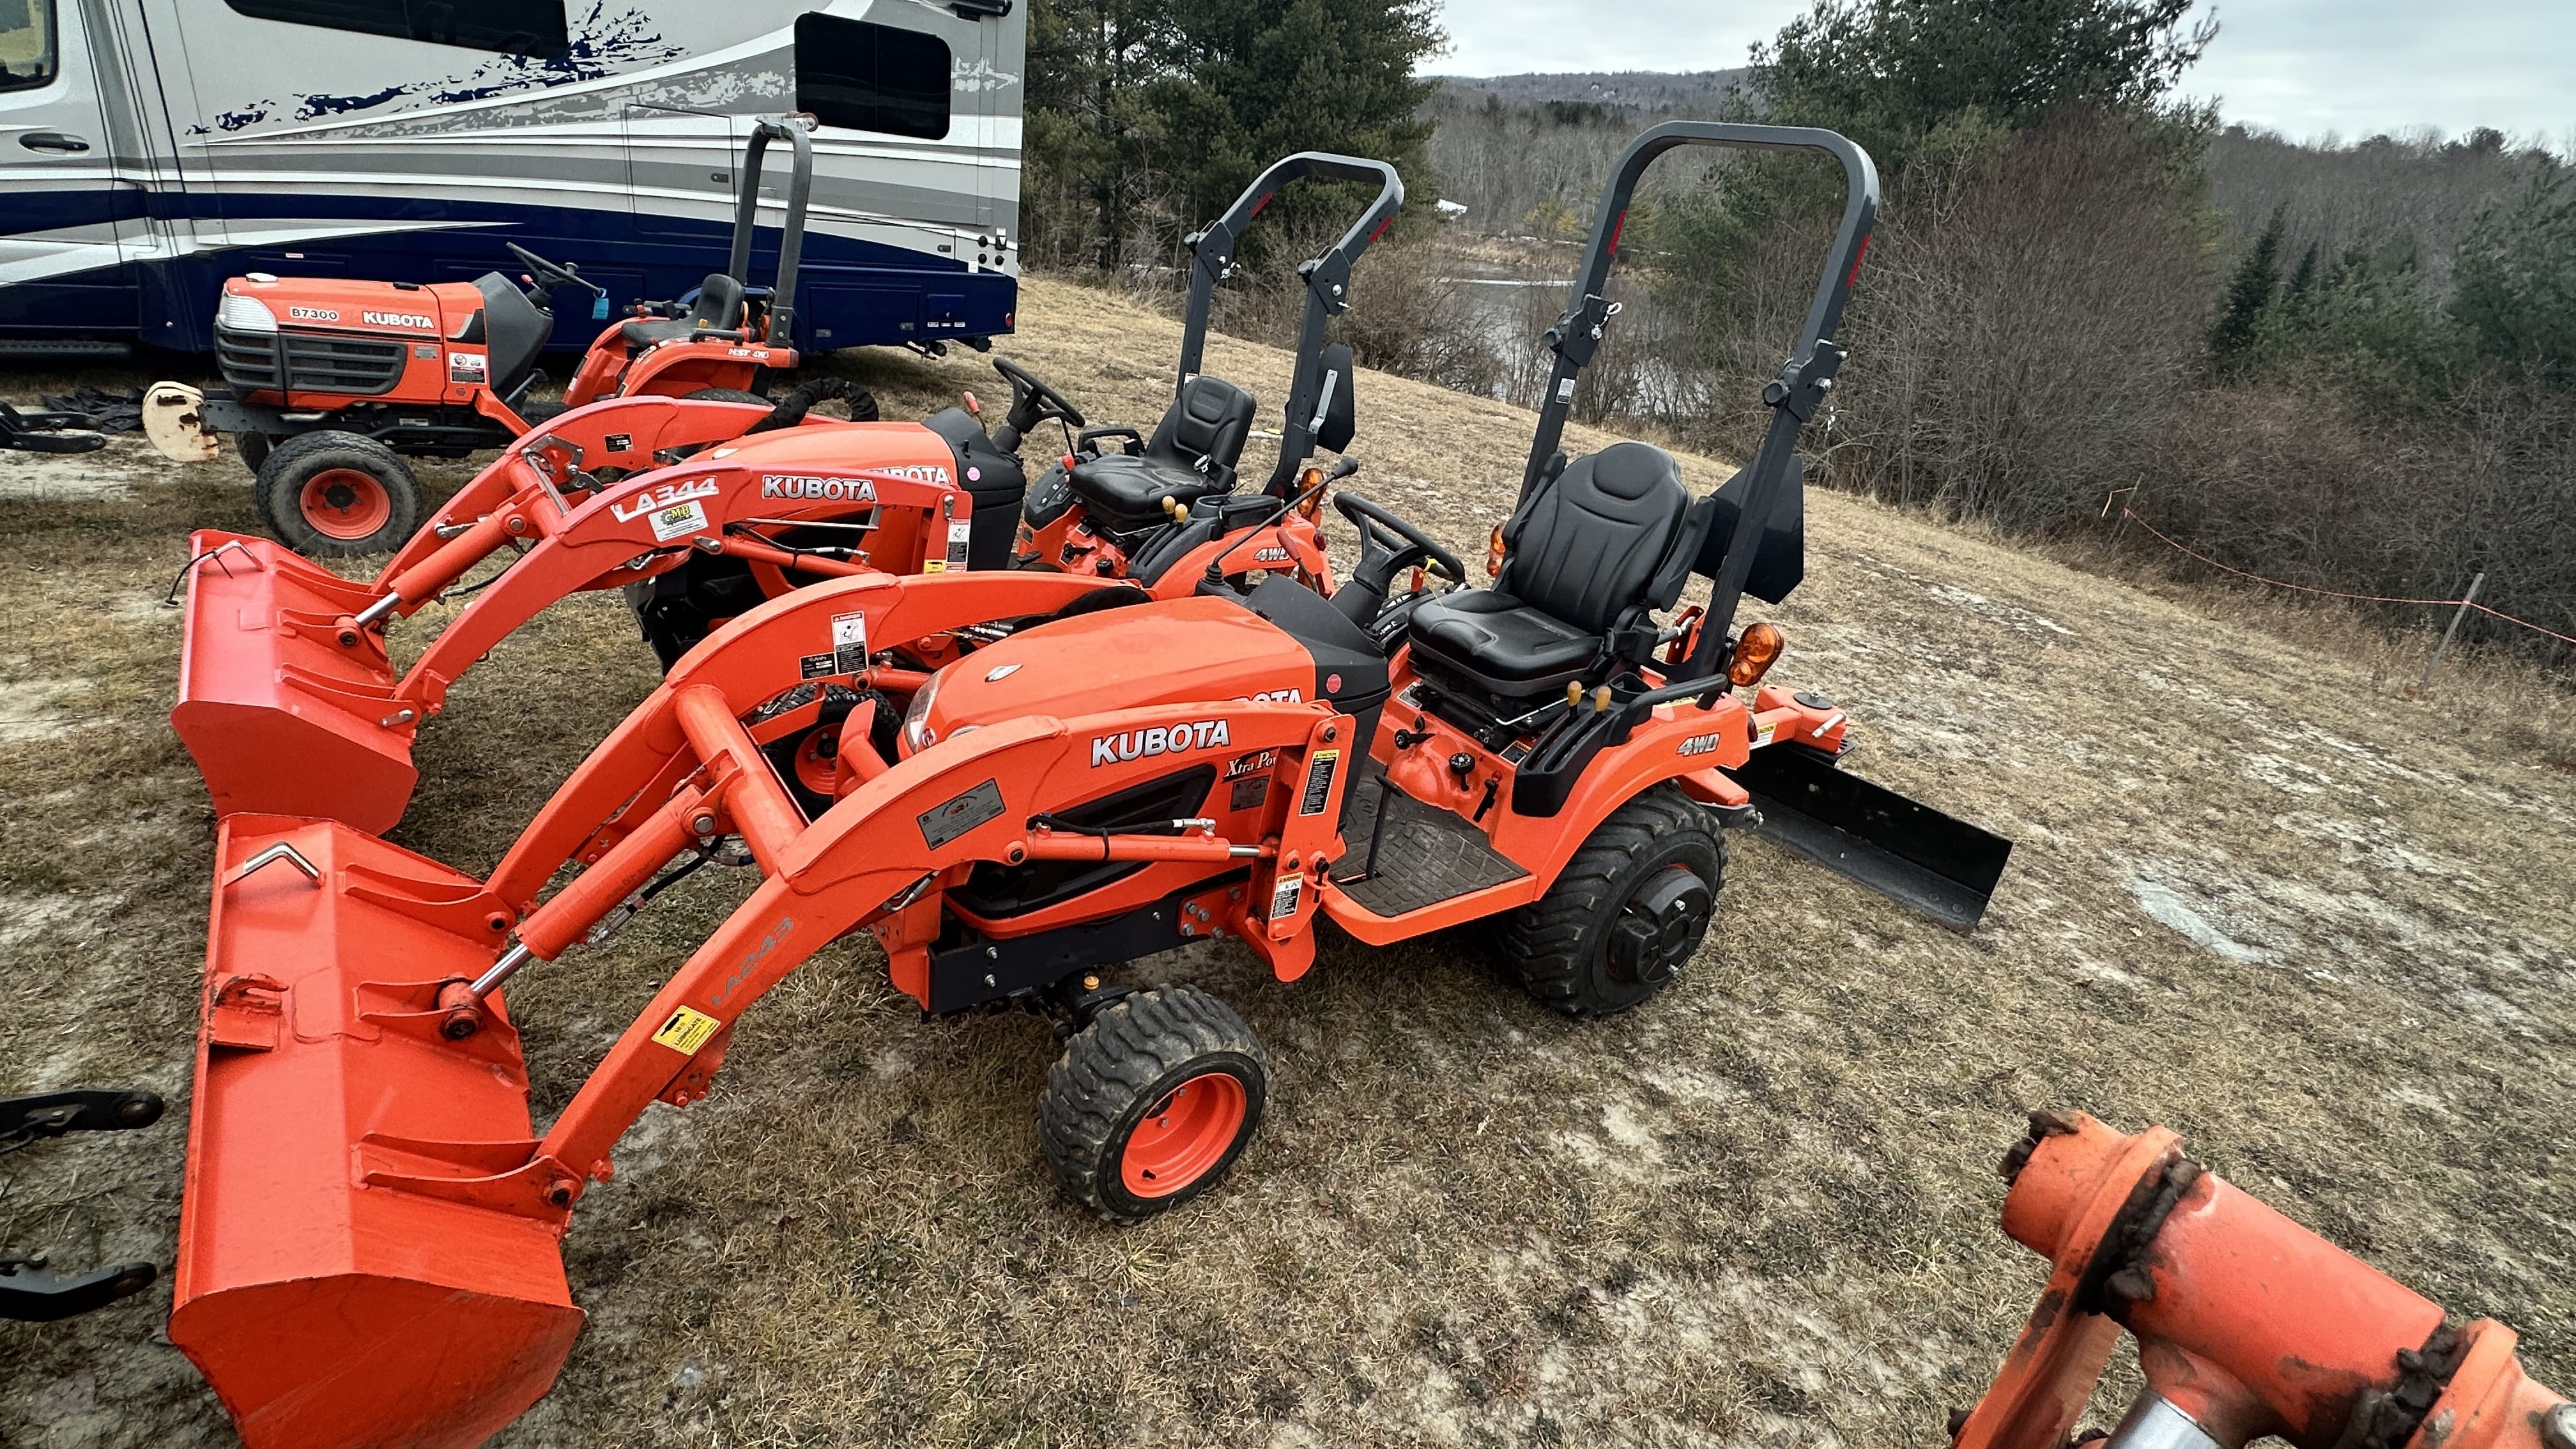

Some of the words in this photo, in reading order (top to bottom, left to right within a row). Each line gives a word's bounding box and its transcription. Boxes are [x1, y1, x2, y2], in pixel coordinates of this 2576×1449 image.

[291, 308, 337, 319] B7300
[362, 311, 435, 328] KUBOTA
[610, 475, 719, 523] LA344
[763, 477, 877, 502] KUBOTA
[1091, 719, 1230, 767] KUBOTA
[1676, 732, 1721, 757] 4WD
[1223, 758, 1255, 778] Xtra
[710, 916, 793, 1006] LA243
